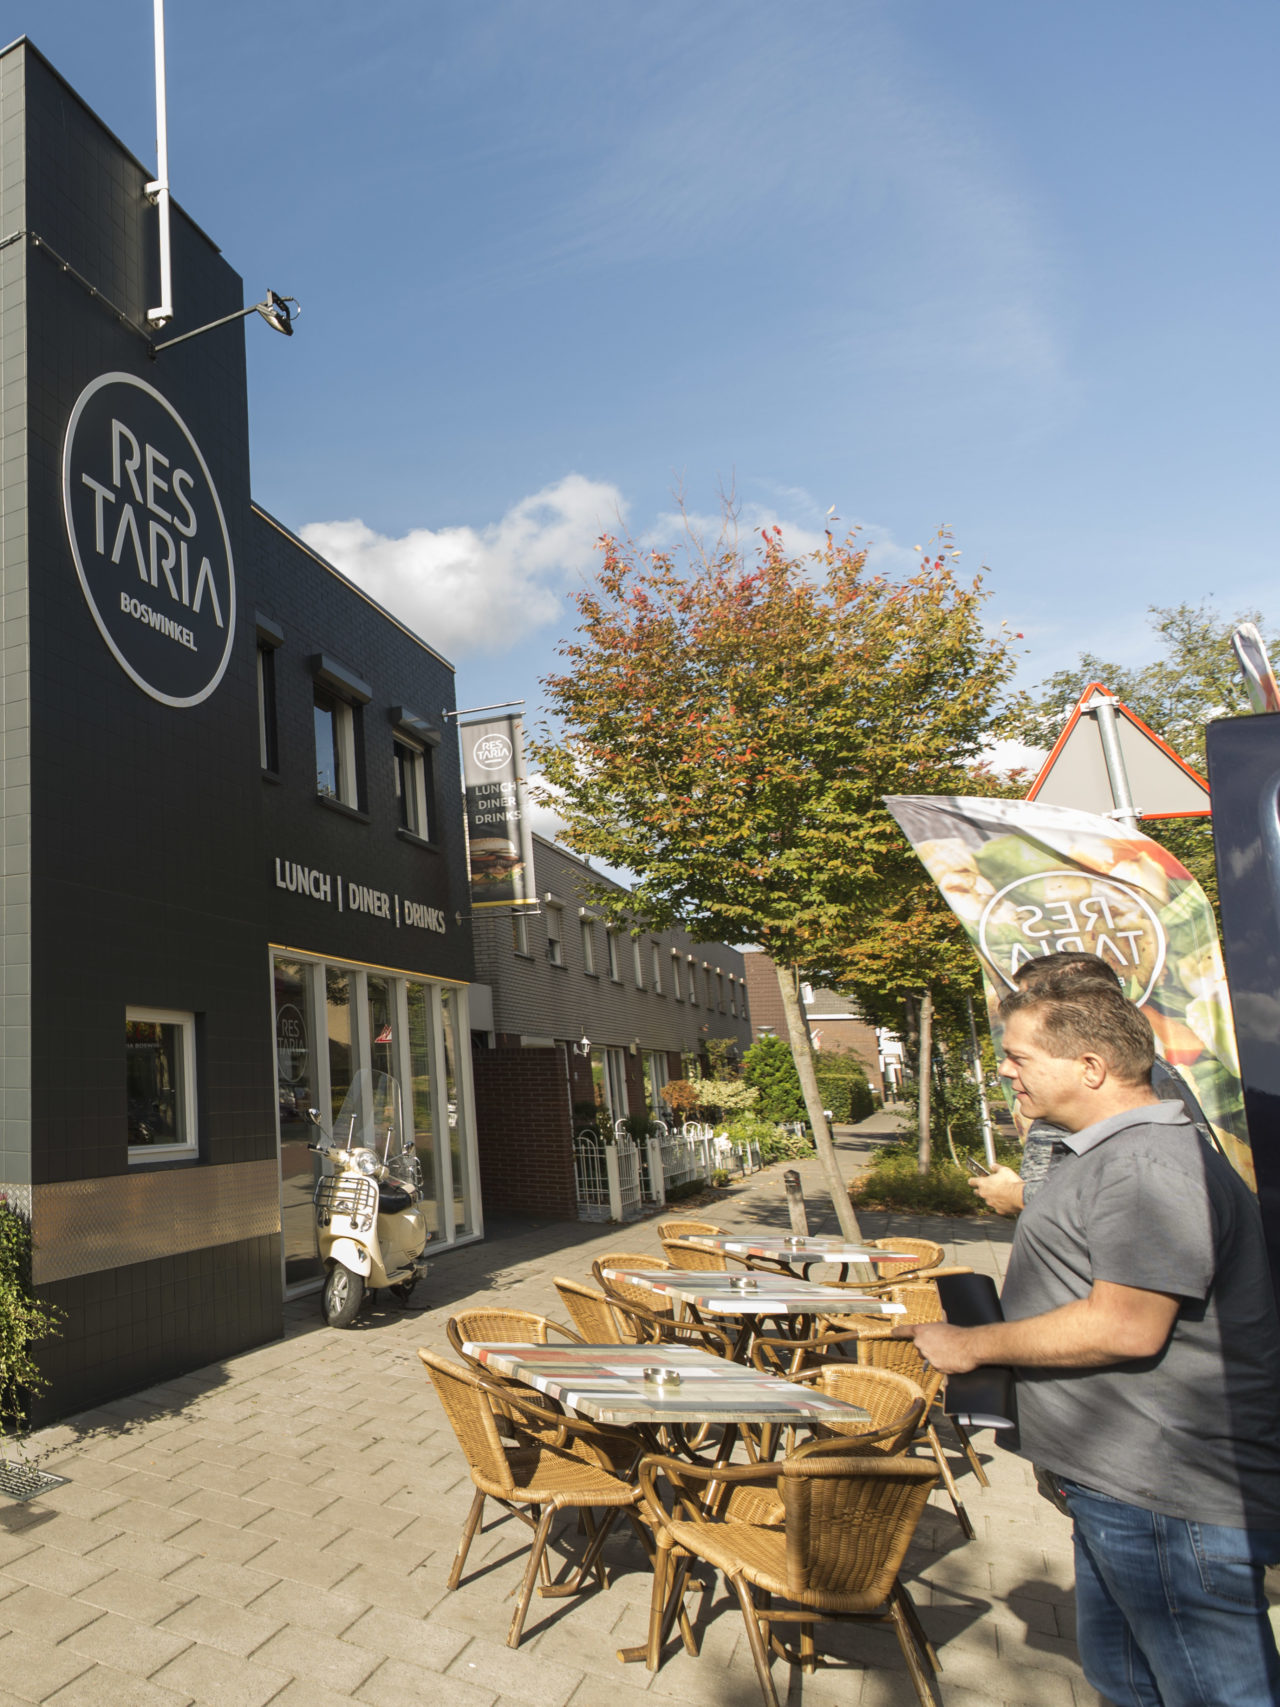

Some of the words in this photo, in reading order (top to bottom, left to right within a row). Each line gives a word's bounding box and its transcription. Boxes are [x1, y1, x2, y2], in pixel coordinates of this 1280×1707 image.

[111, 418, 198, 538] RES
[82, 472, 224, 629] TARIA
[120, 591, 198, 652] BOSWINKEL
[482, 739, 503, 751] RES
[475, 782, 517, 796] LUNCH
[478, 796, 517, 810] DINER
[475, 810, 522, 825] DRINKS
[275, 857, 332, 902] LUNCH
[348, 882, 391, 919] DINER
[405, 900, 446, 934] DRINKS
[281, 1018, 300, 1038] RES
